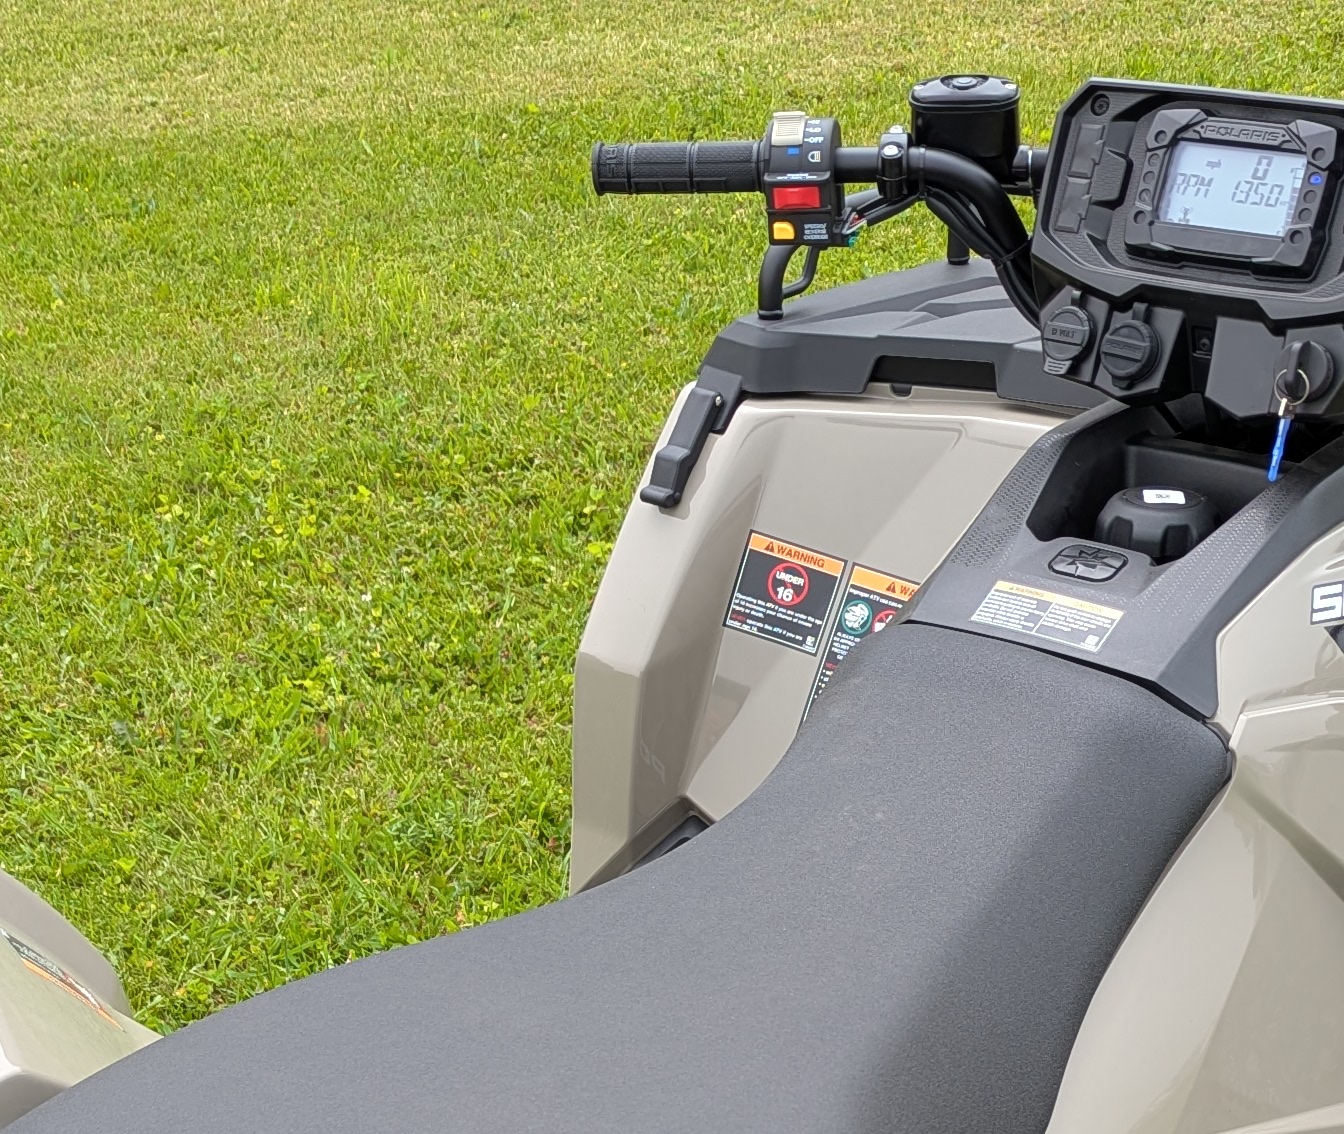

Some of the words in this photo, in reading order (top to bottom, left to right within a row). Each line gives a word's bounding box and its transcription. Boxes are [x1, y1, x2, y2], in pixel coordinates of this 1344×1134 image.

[1204, 124, 1280, 142] POLARIS
[1206, 159, 1222, 169] mph
[1252, 155, 1274, 181] 0
[1174, 172, 1214, 198] RPM
[1231, 181, 1285, 207] 1350
[777, 545, 825, 568] WARNING
[776, 571, 804, 586] UNDER
[776, 586, 793, 602] 16
